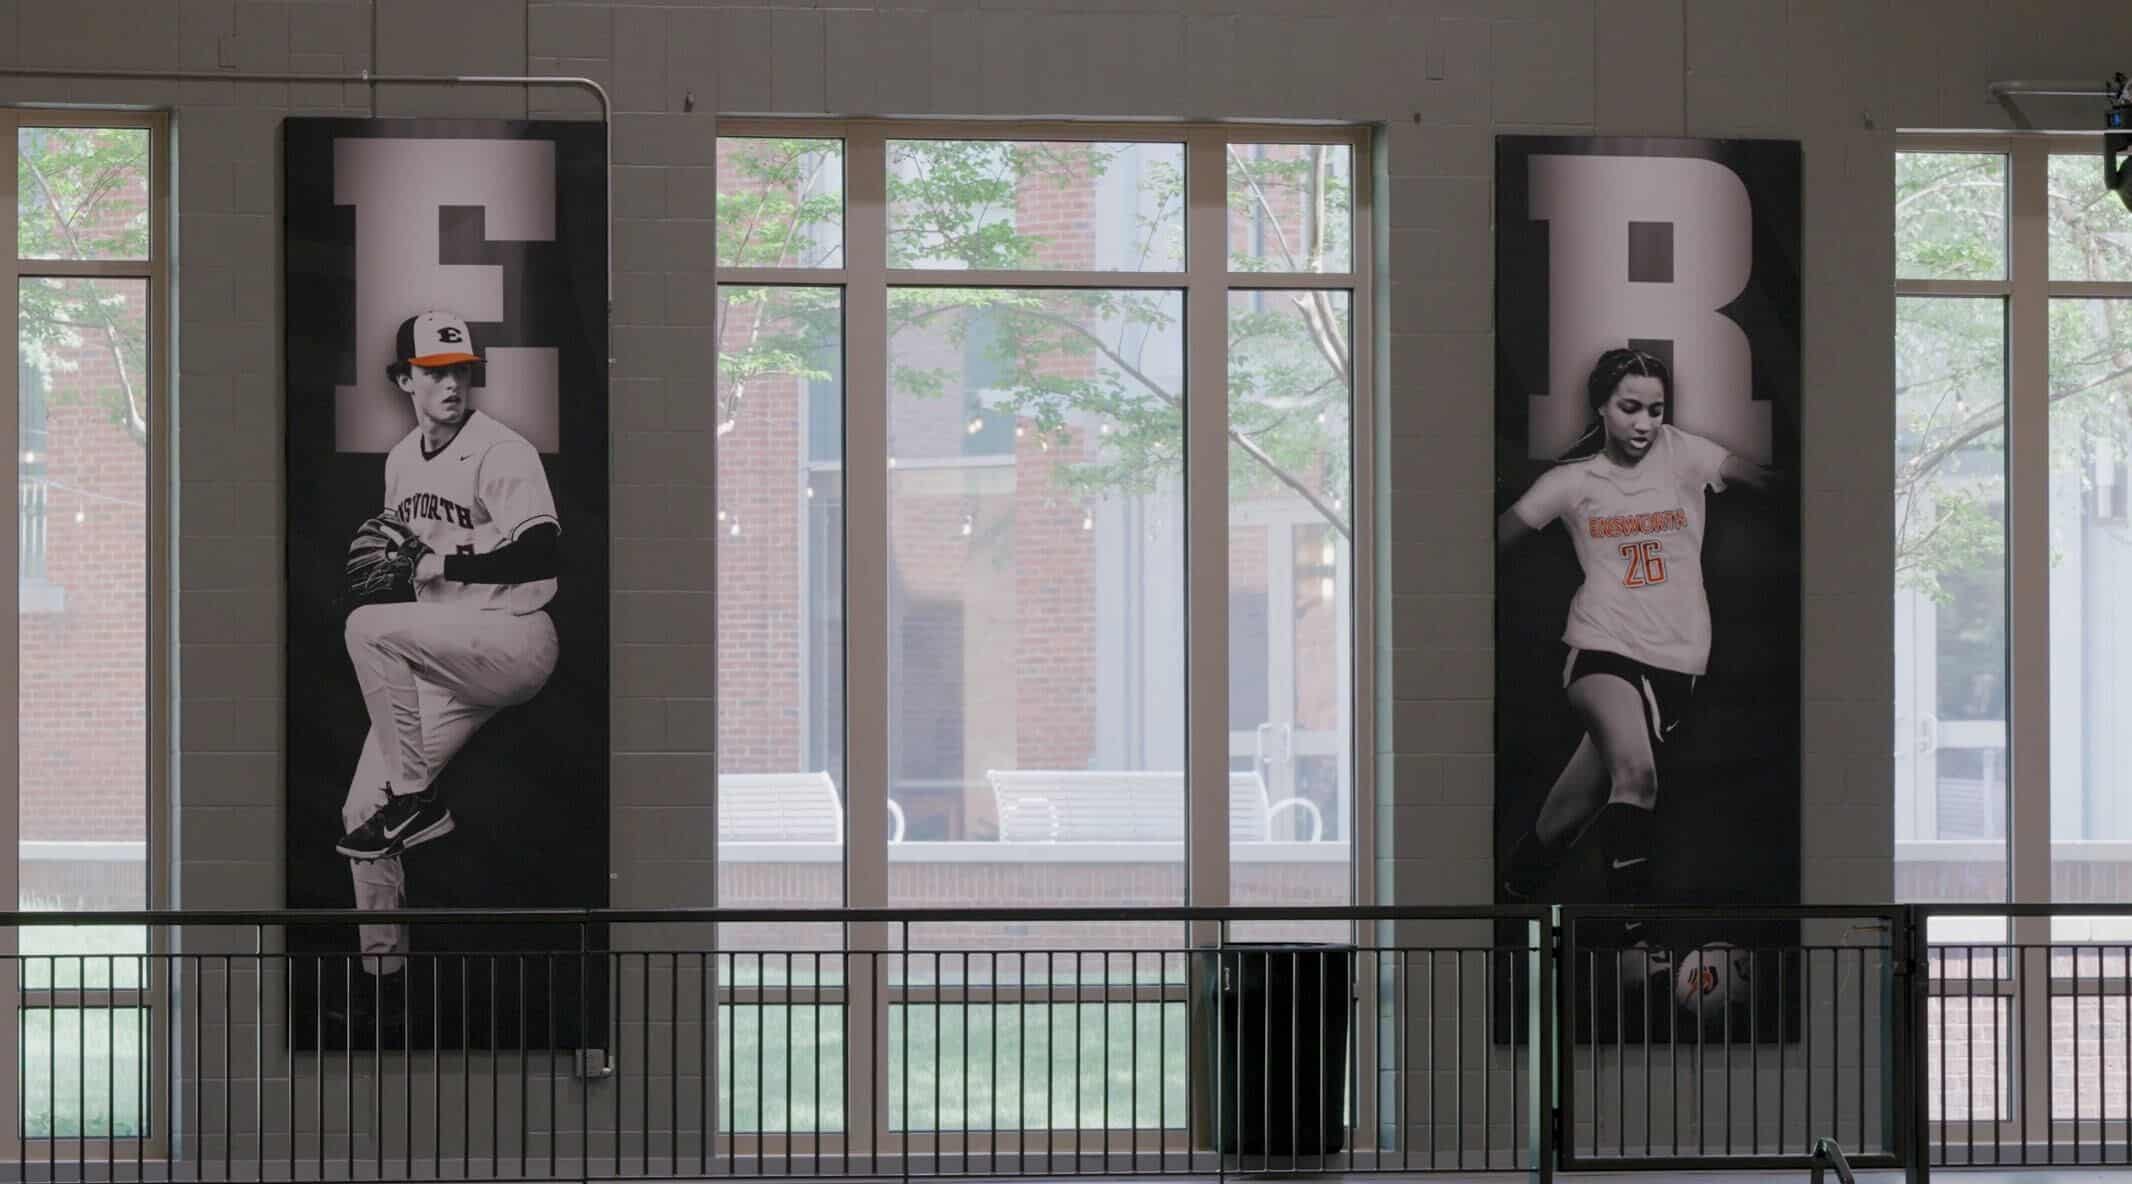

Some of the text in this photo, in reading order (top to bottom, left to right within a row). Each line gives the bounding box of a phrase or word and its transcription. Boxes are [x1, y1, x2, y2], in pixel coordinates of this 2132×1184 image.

[333, 137, 560, 454] E
[1527, 154, 1773, 466] R
[1618, 539, 1667, 589] 26
